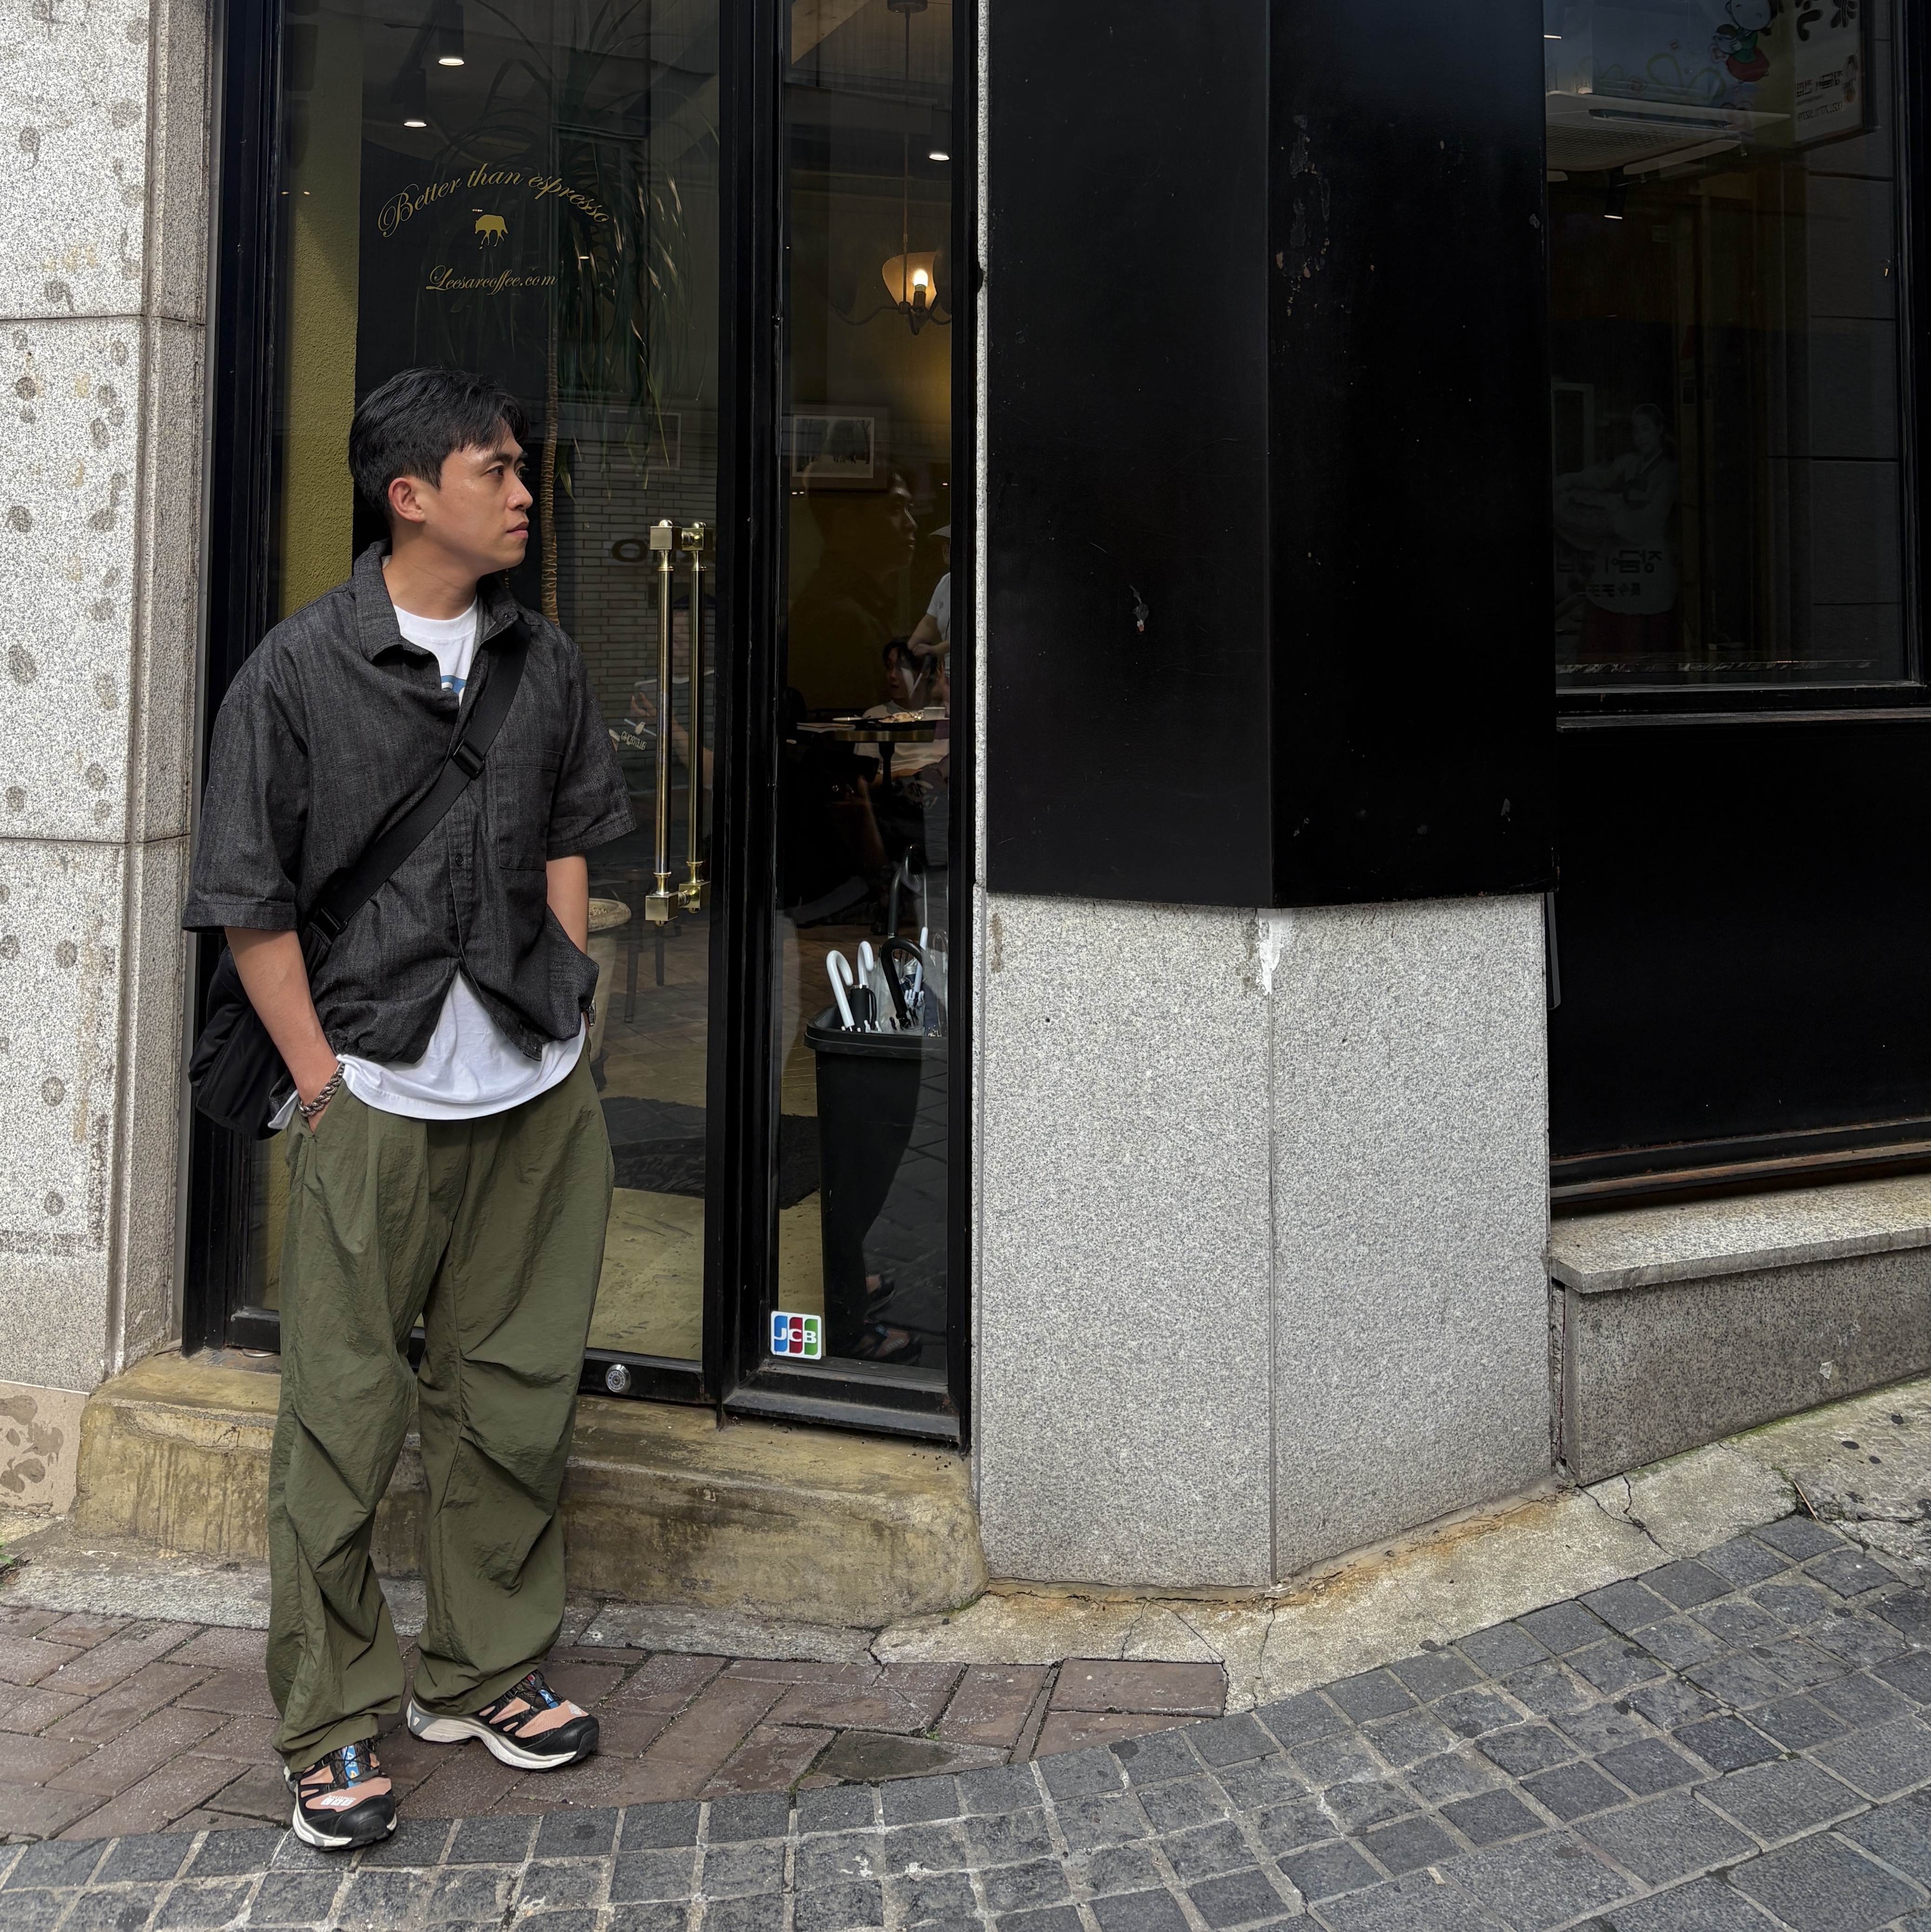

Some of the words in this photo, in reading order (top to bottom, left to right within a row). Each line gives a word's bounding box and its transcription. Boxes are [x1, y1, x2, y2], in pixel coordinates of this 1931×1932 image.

[378, 178, 462, 237] Better
[467, 163, 524, 188] than
[529, 176, 609, 222] espresso
[426, 265, 558, 295] Leesarcoffee.com
[774, 1327, 817, 1344] JCB
